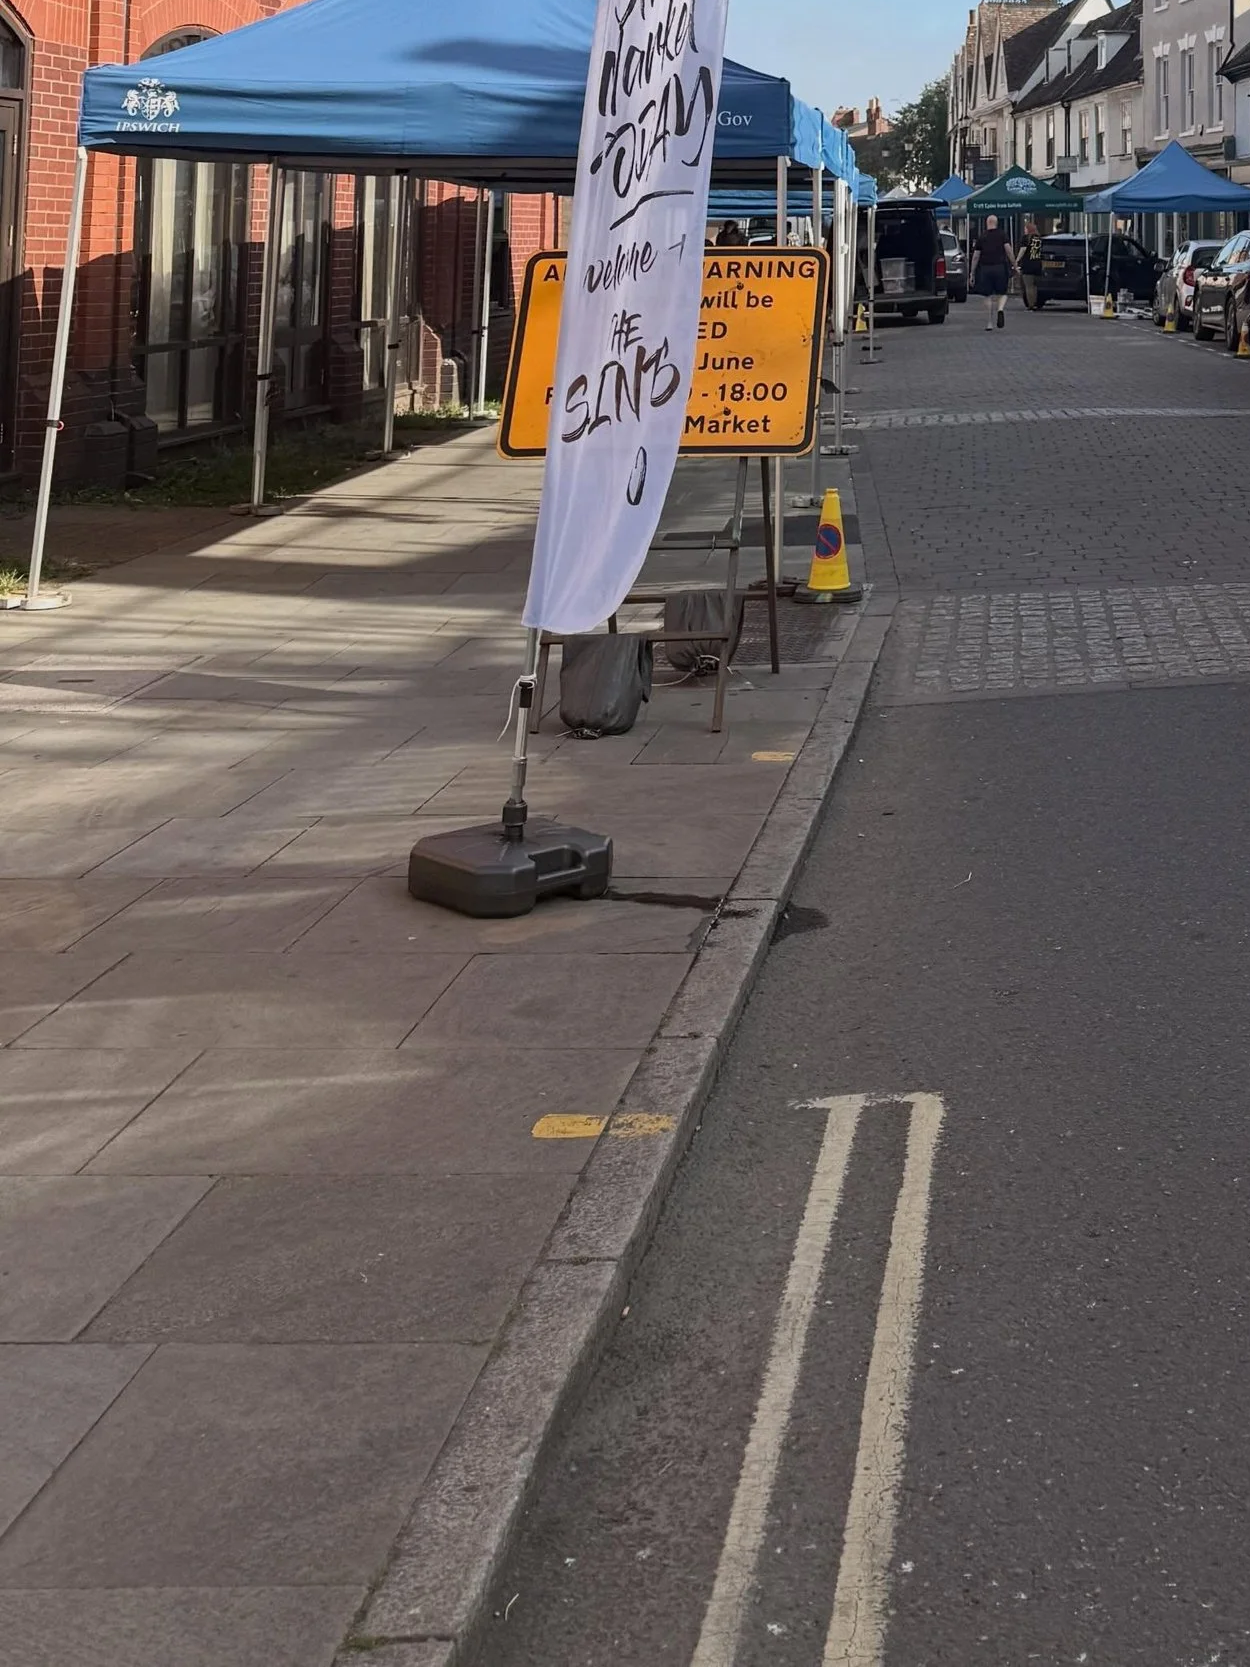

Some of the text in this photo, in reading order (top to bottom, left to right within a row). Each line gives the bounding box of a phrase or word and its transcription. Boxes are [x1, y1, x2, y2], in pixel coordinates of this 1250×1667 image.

[115, 121, 180, 133] IPSWICH
[717, 110, 753, 126] Gov
[703, 260, 816, 280] ARNING
[700, 291, 774, 310] will be
[698, 353, 755, 371] June
[718, 382, 788, 402] 18:00
[685, 415, 771, 434] Market
